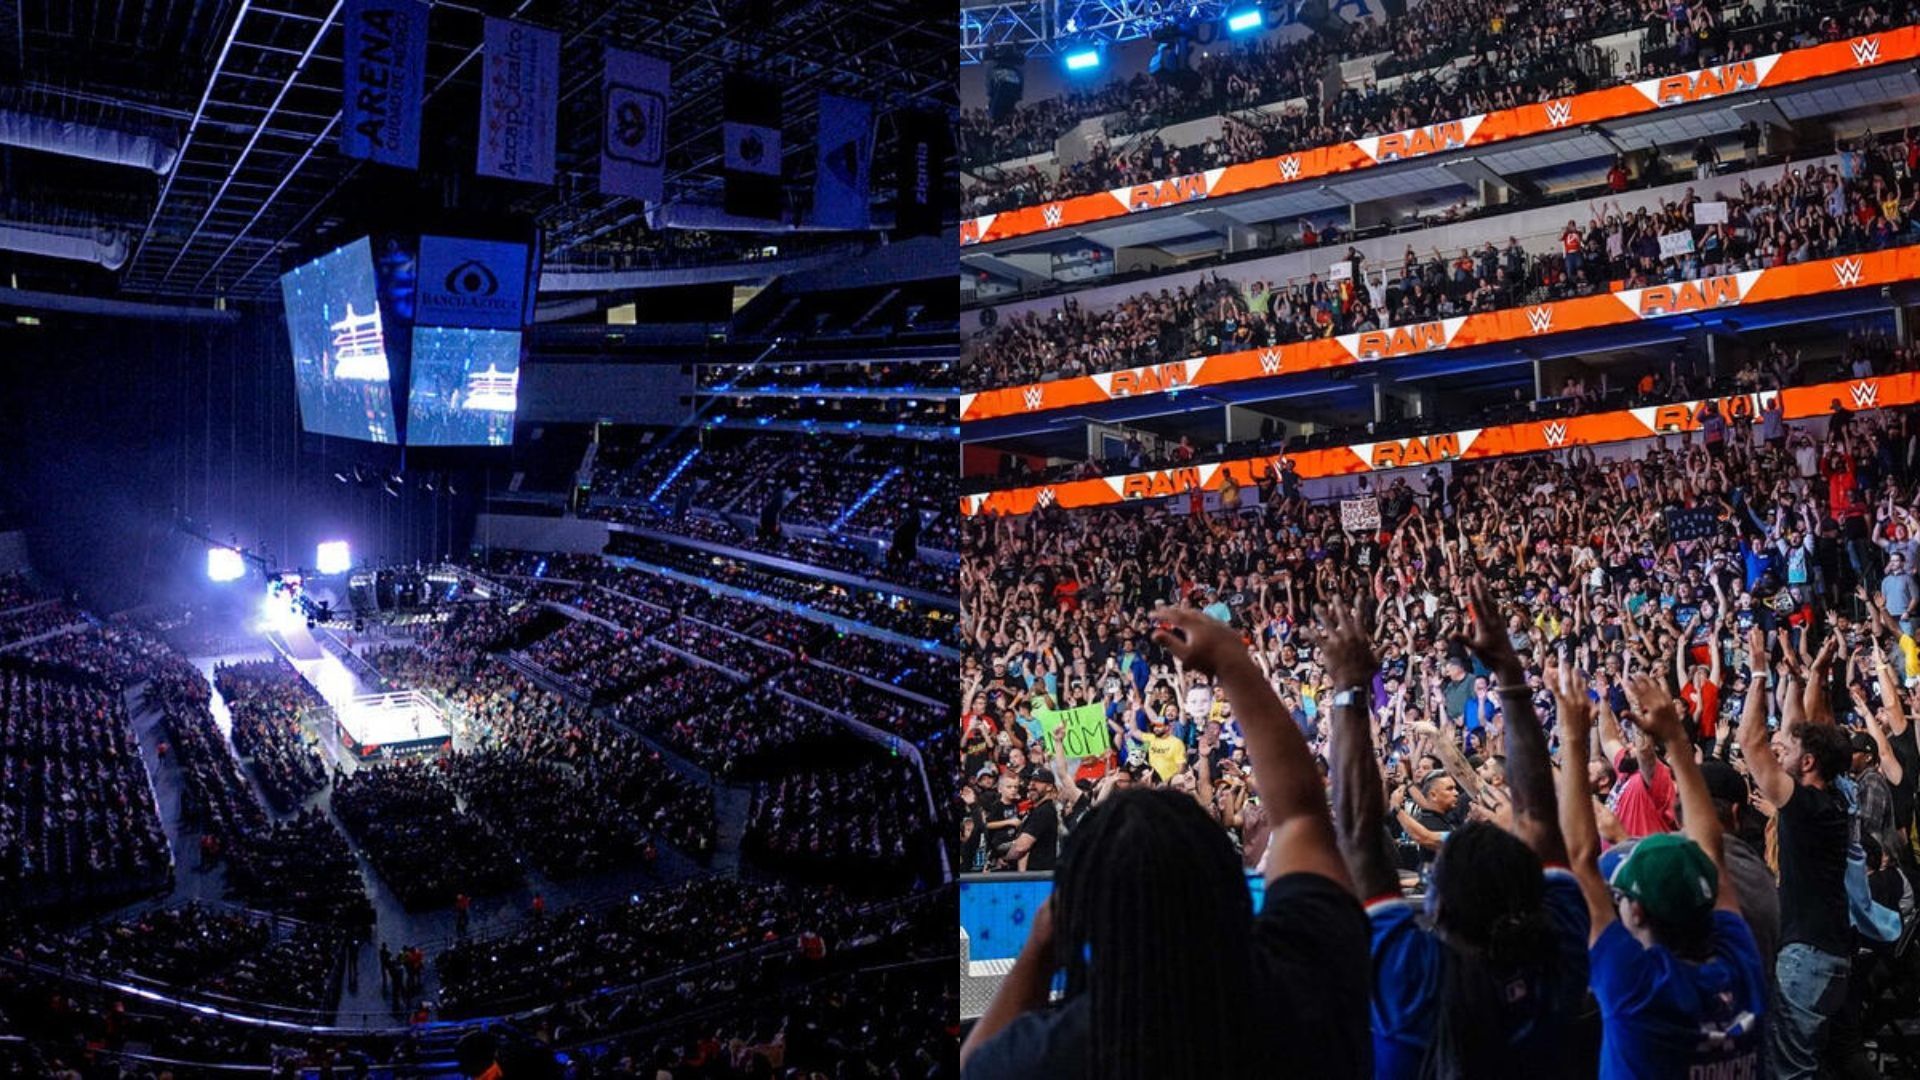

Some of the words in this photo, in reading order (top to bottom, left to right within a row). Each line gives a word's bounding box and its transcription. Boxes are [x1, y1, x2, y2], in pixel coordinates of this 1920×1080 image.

[357, 8, 391, 147] ARENA
[1657, 61, 1760, 103] RAW
[1376, 121, 1464, 161] RAW
[1130, 174, 1208, 210] RAW
[1638, 276, 1741, 317] RAW
[1357, 321, 1448, 358] RAW
[1110, 363, 1189, 397] RAW
[1371, 432, 1459, 468] RAW
[1123, 468, 1200, 498] RAW
[1047, 721, 1106, 756] MOM
